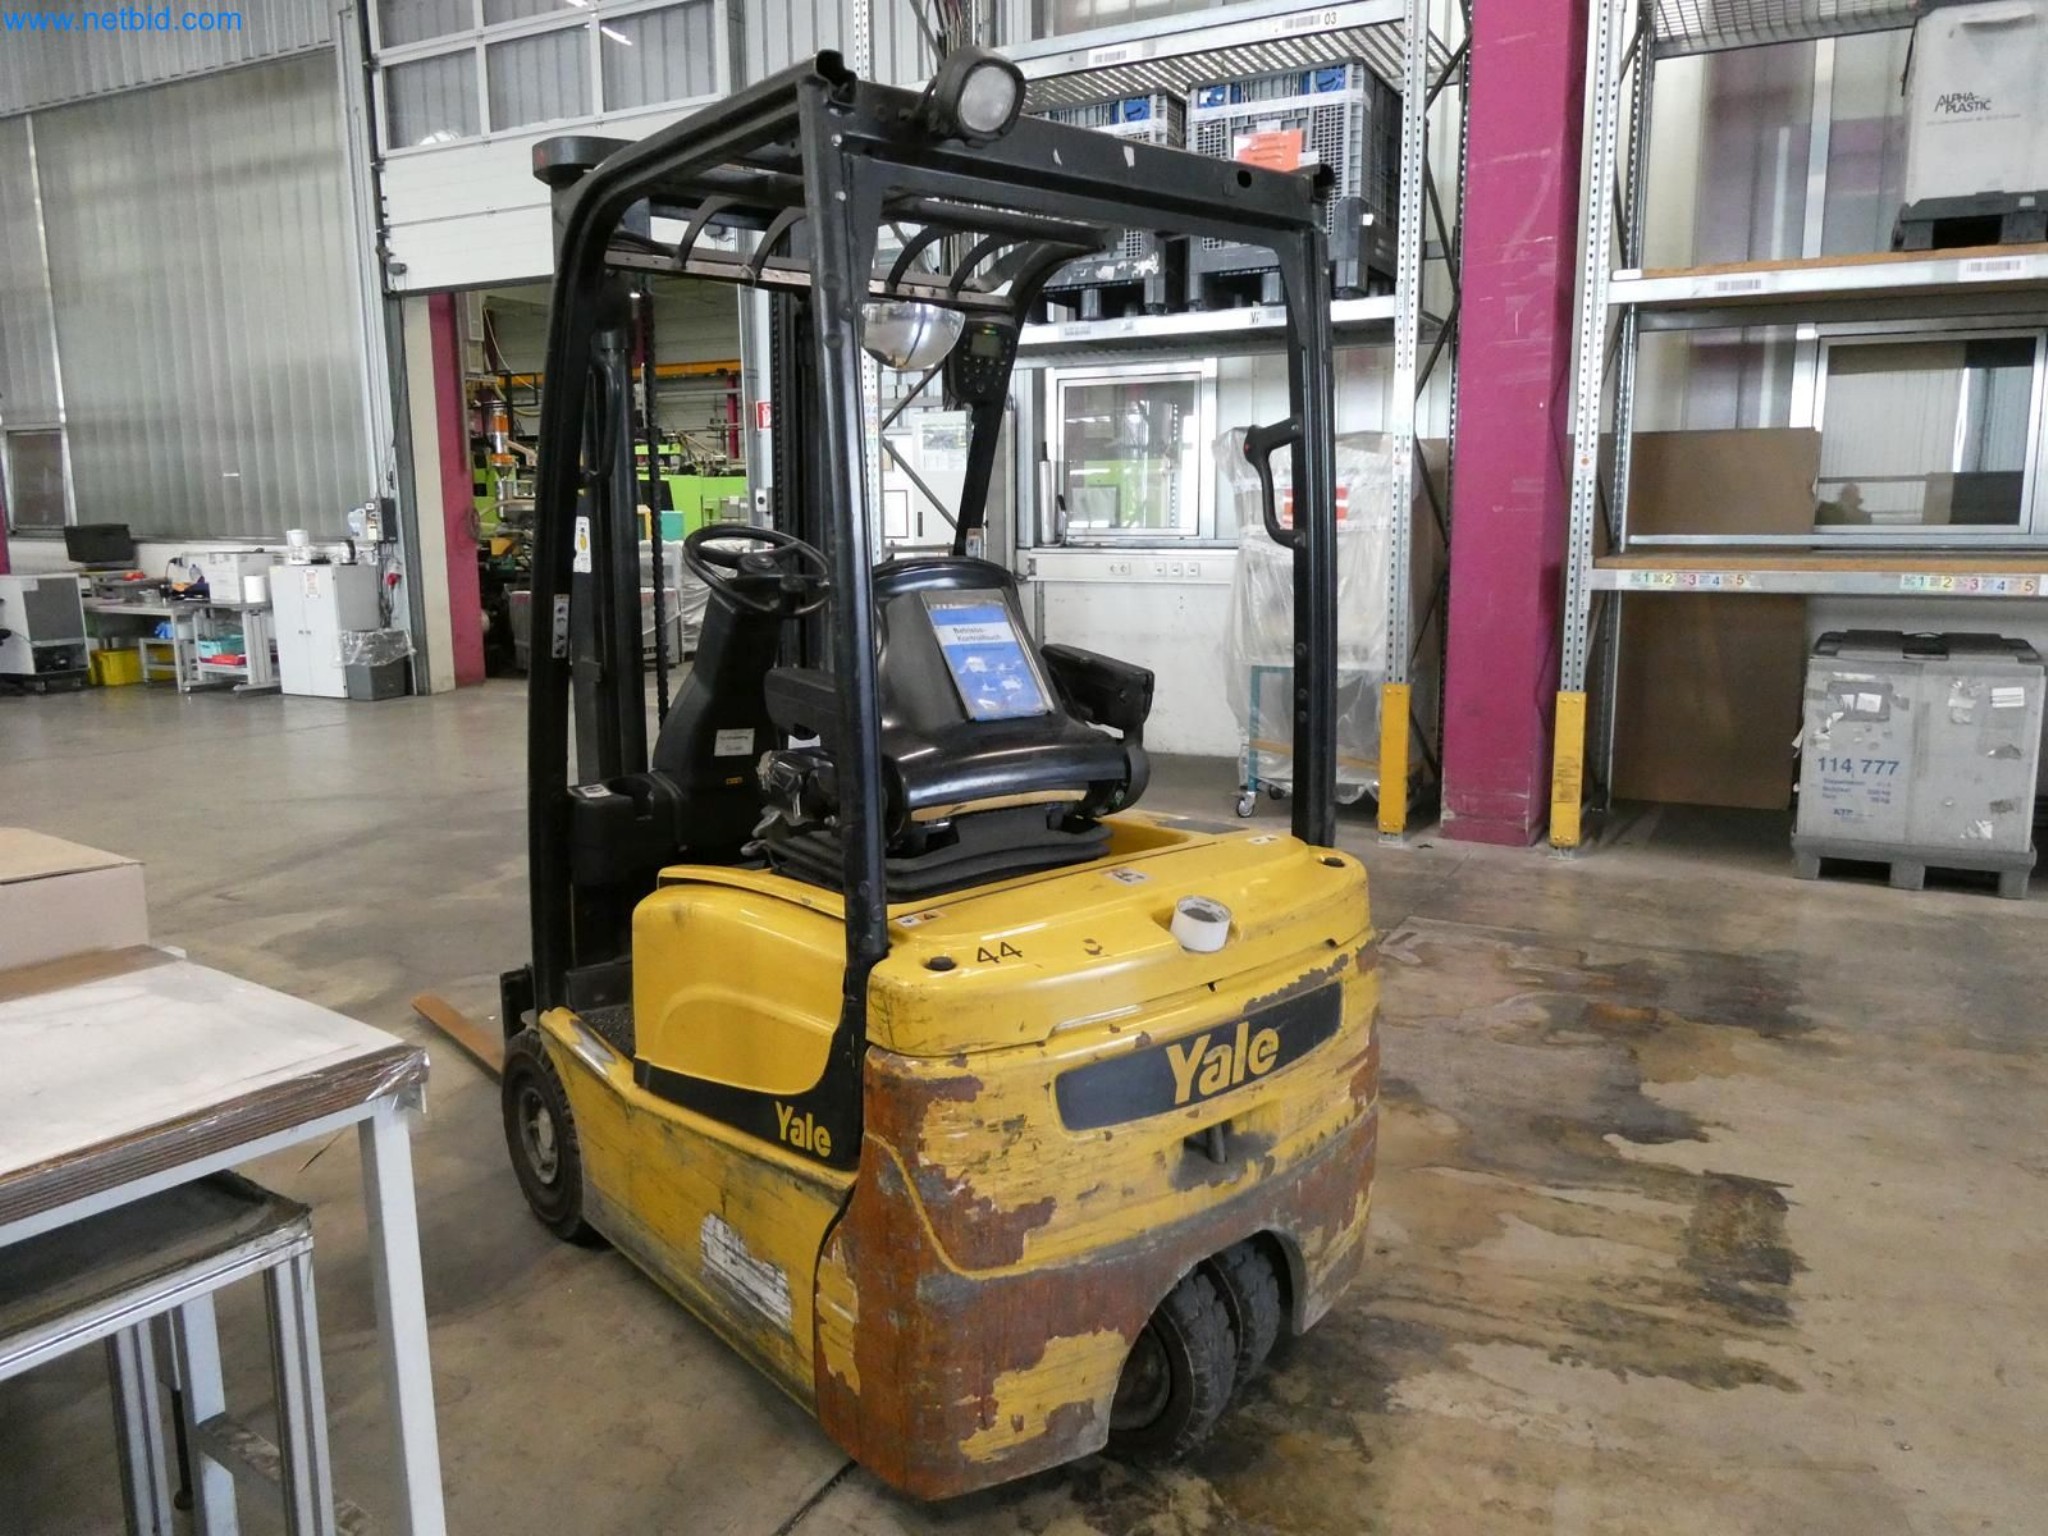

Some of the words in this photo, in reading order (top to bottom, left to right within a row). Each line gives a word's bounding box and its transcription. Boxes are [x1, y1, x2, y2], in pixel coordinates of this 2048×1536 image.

[1324, 11, 1338, 25] 03
[1944, 99, 1992, 114] PLASTIC
[1818, 757, 1852, 773] 114
[1860, 759, 1900, 776] 777
[977, 941, 1023, 964] 44
[1165, 1021, 1280, 1105] Yale
[775, 1100, 832, 1158] Yale
